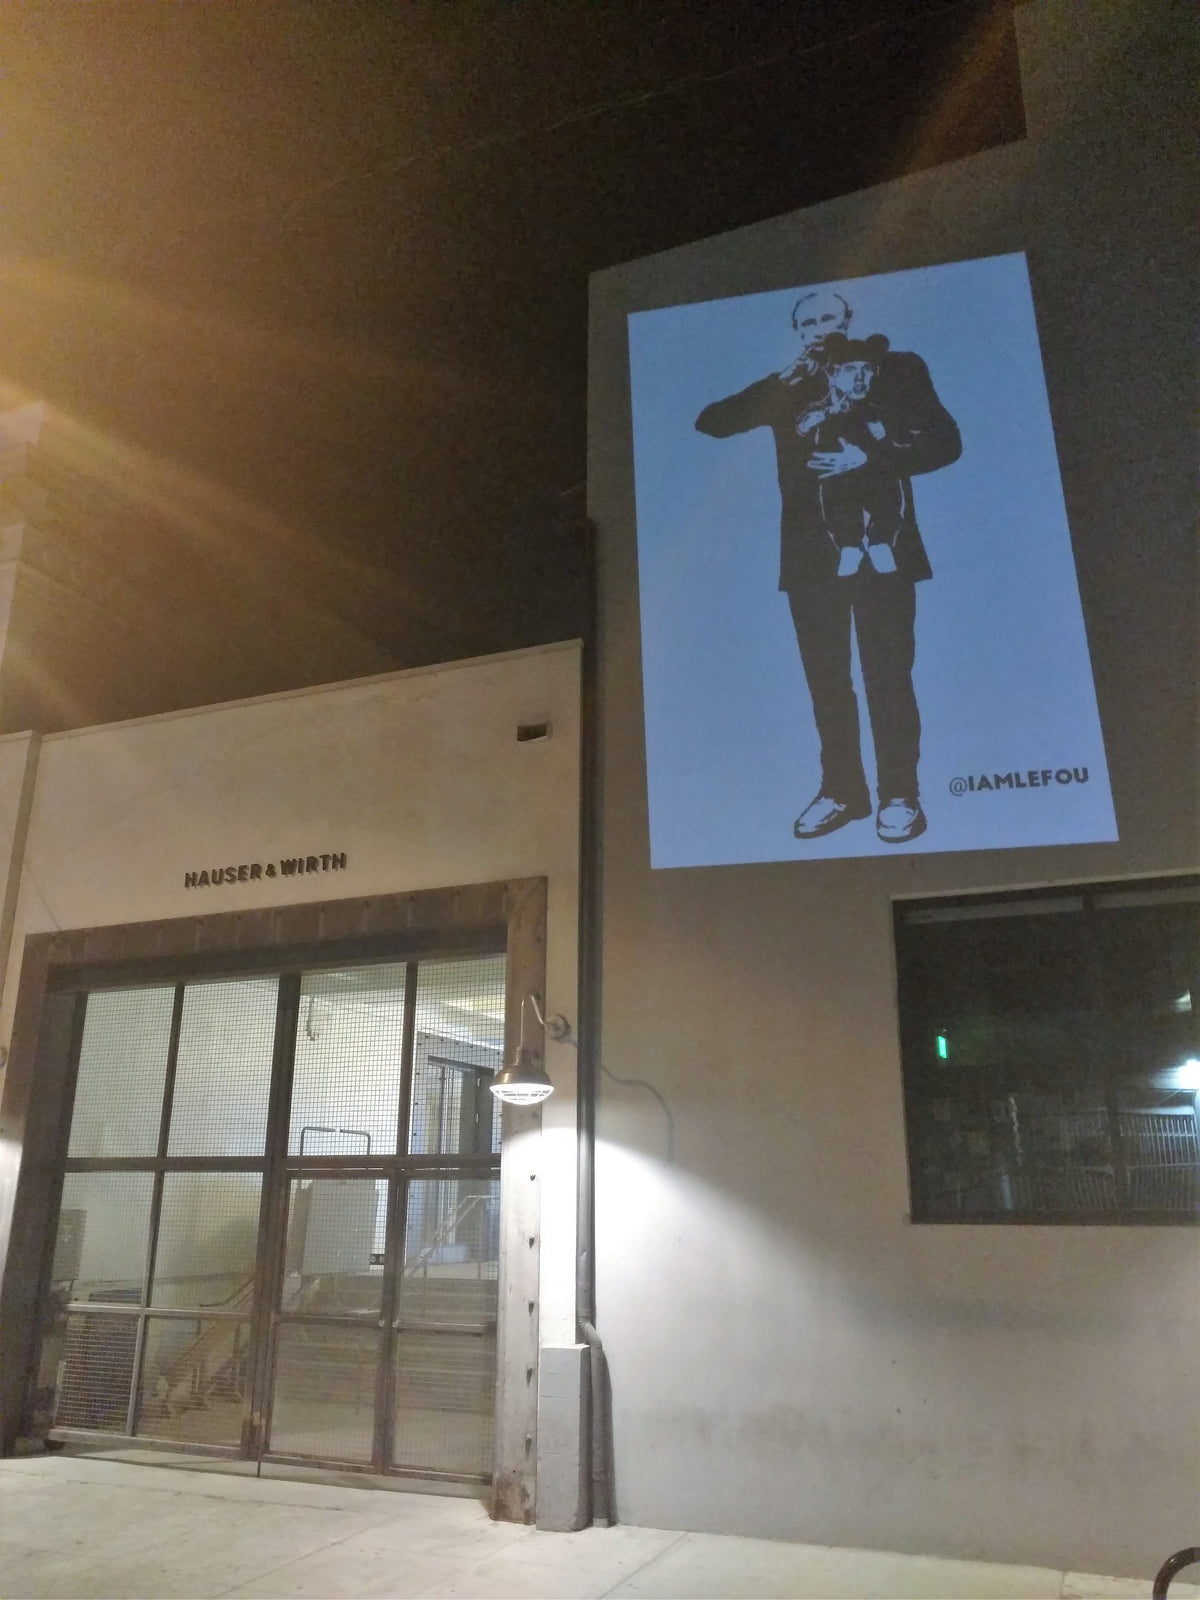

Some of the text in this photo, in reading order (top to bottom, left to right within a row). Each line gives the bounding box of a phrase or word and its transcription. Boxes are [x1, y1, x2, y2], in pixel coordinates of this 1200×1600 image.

[950, 767, 1089, 797] @IAMLEFOU
[184, 852, 347, 888] HAUSER & WIRTH
